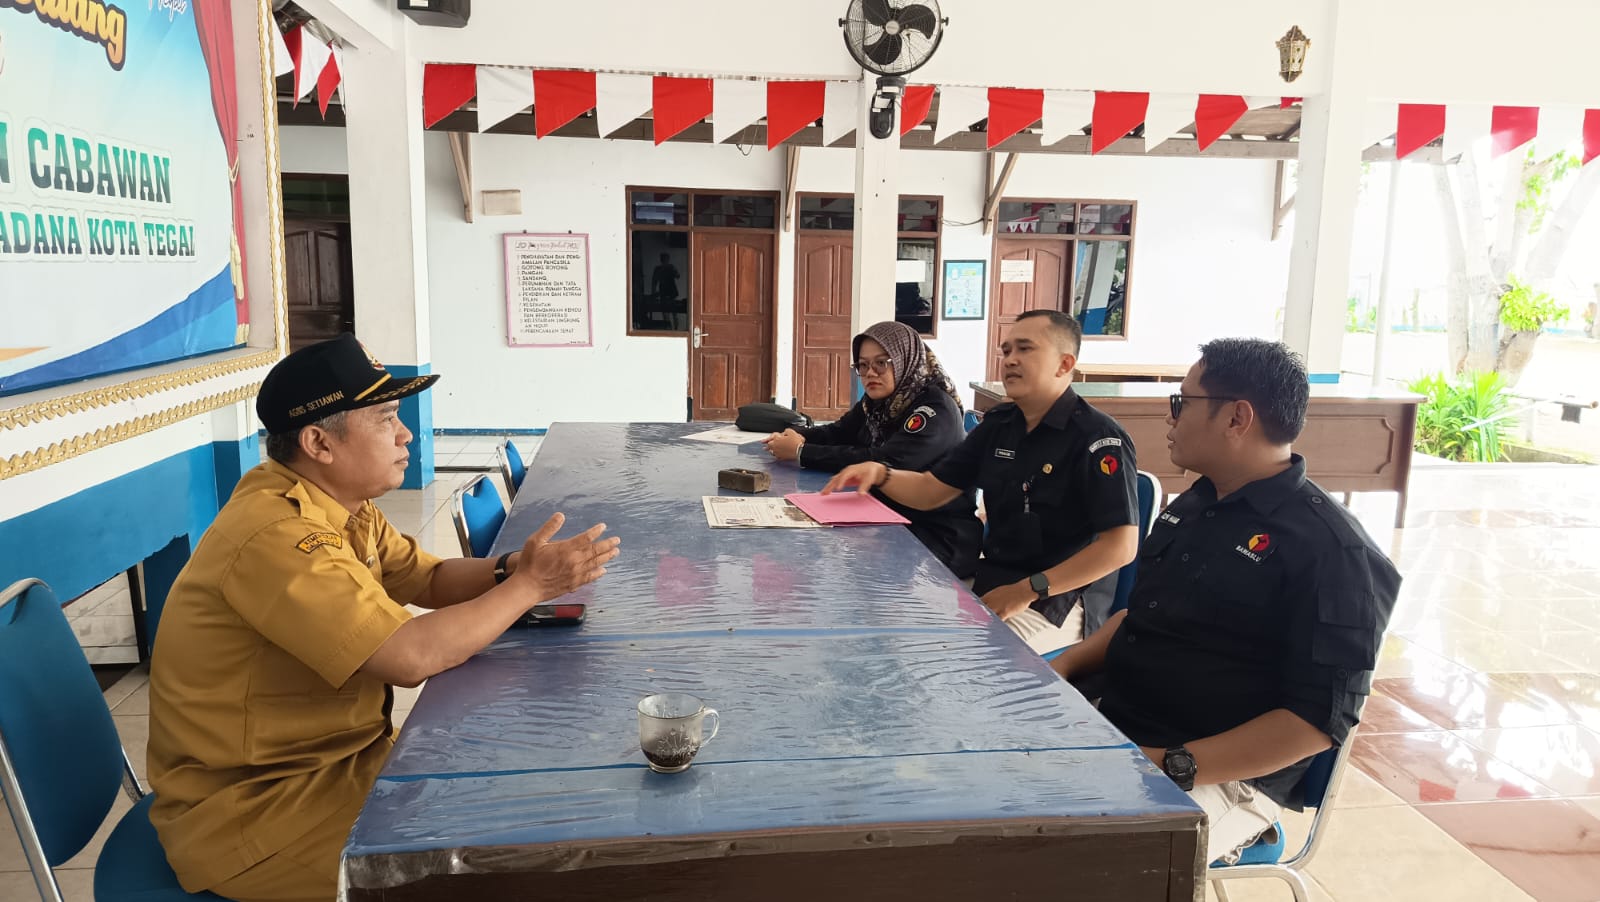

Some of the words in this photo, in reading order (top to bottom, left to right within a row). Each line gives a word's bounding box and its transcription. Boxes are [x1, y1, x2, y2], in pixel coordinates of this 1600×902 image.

[27, 127, 171, 203] CABAWAN
[87, 217, 140, 255] KOTA
[144, 222, 195, 256] TEGAL
[306, 390, 345, 411] SETIAWAN
[1235, 544, 1263, 563] BAWASLU
